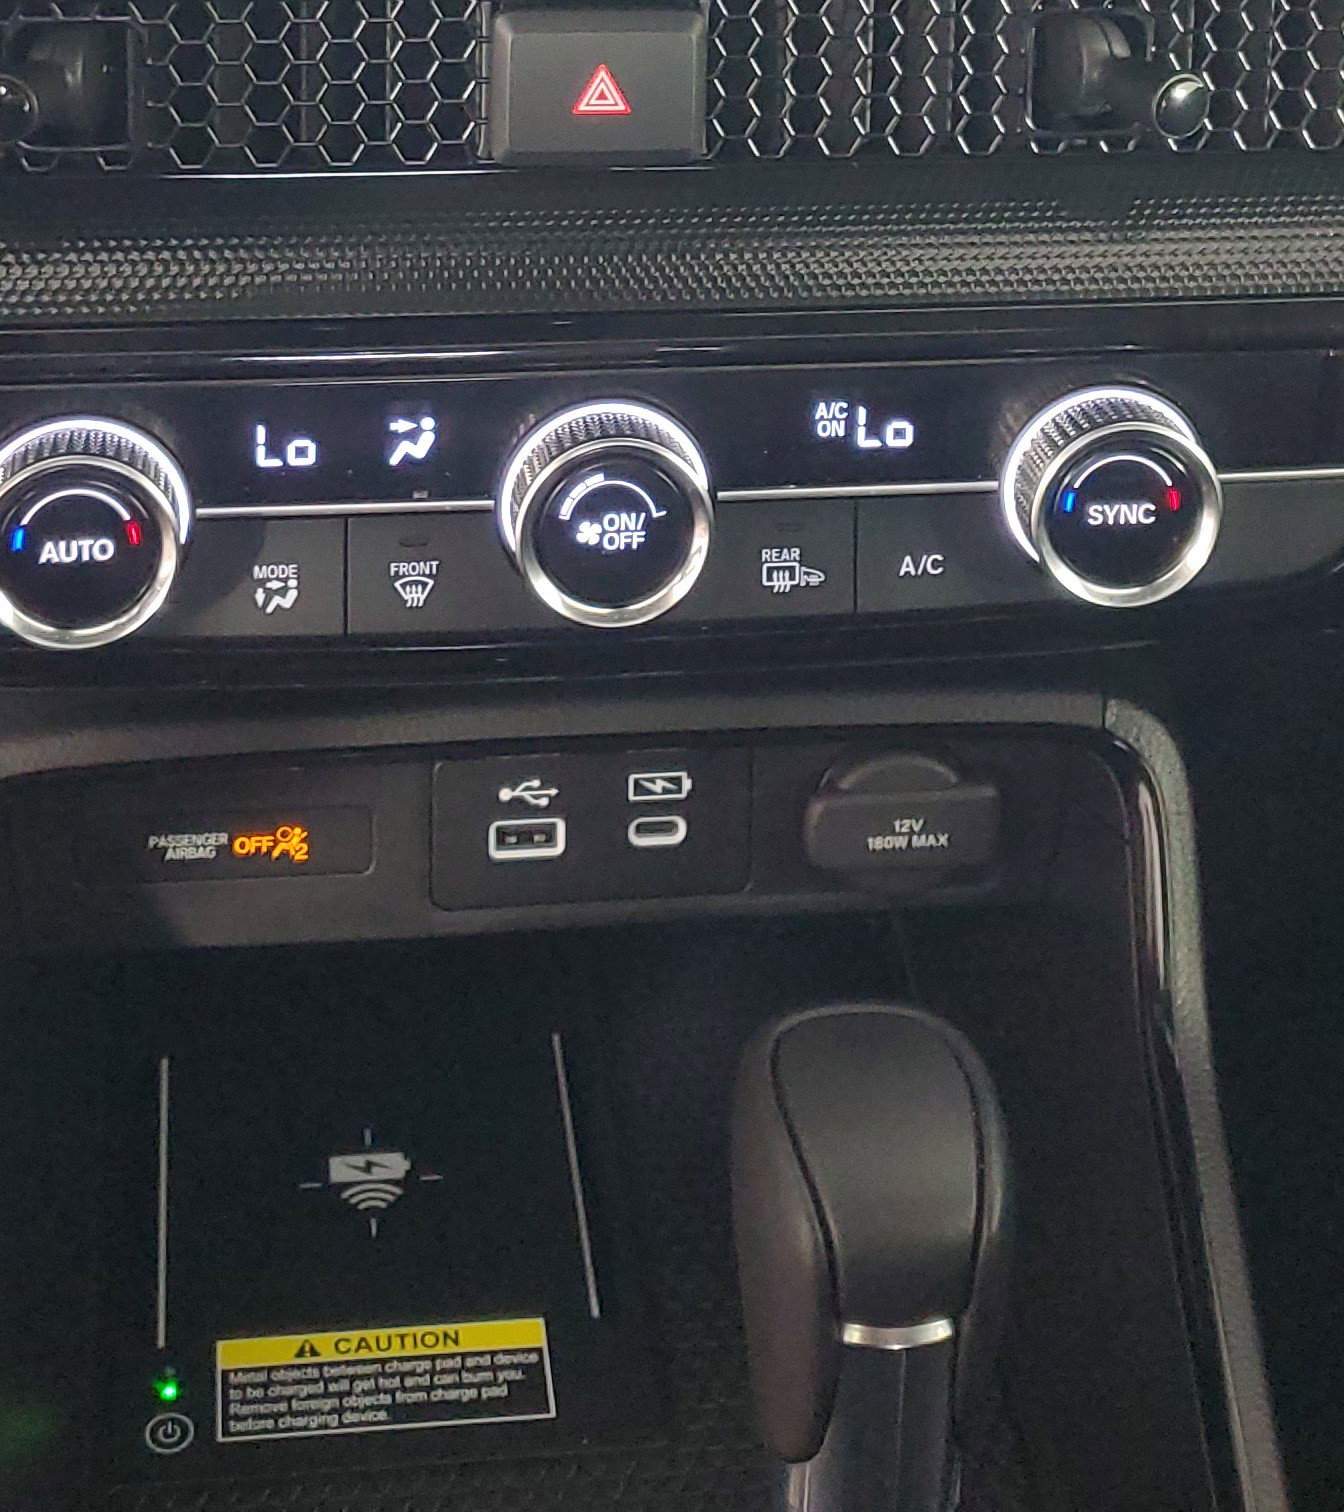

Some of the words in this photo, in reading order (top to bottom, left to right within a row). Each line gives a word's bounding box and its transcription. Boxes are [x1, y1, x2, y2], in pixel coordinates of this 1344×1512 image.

[815, 401, 849, 420] A/C
[817, 419, 846, 439] ON
[857, 405, 915, 448] Lo
[254, 423, 318, 468] Lo
[603, 512, 645, 532] ON/
[1086, 504, 1156, 527] SYNC
[602, 530, 646, 552] OFF
[38, 537, 115, 566] AUTO
[761, 548, 800, 564] REAR
[254, 563, 299, 581] MODE
[390, 560, 439, 577] FRONT
[898, 553, 945, 578] A/C
[894, 818, 925, 833] 12V
[233, 835, 275, 857] OFF
[911, 833, 950, 849] MAX
[164, 845, 217, 861] AIRBAG
[334, 1329, 460, 1355] CAUTION
